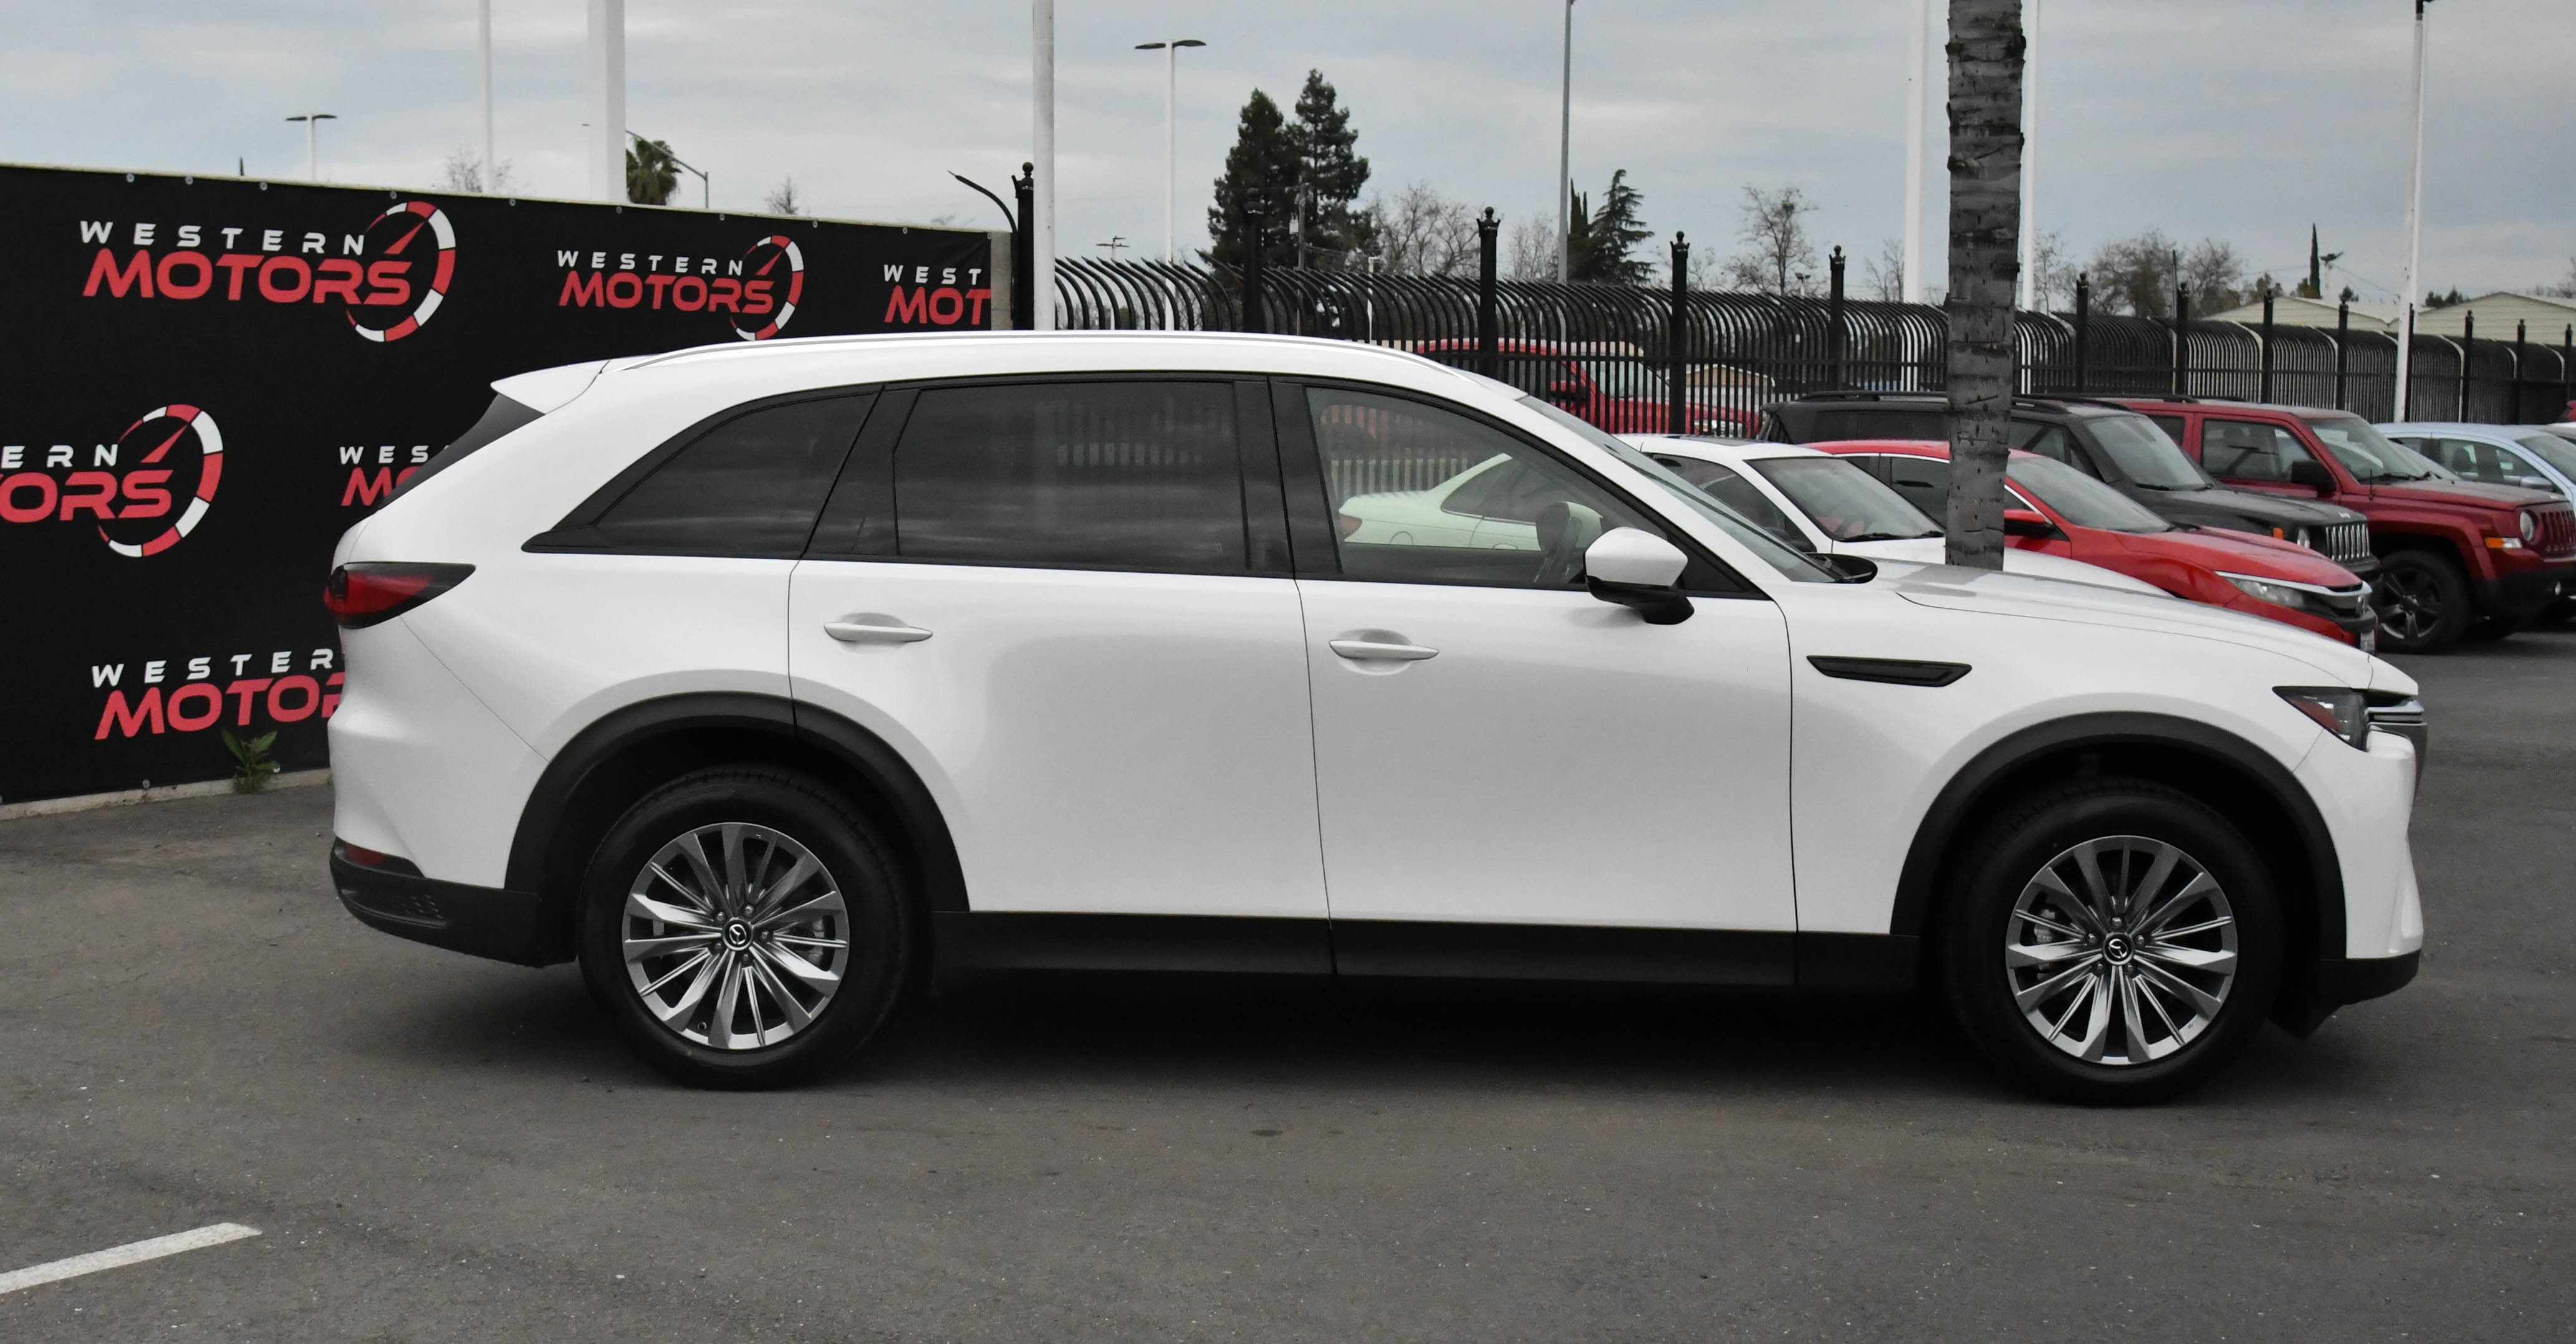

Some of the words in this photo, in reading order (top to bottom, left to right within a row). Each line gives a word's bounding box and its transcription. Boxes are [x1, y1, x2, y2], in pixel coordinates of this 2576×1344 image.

[80, 221, 365, 256] WESTERN
[82, 247, 412, 306] MOTORS
[557, 250, 743, 276] WESTERN
[883, 264, 982, 286] WEST
[558, 270, 775, 314] MOTORS
[884, 285, 991, 325] MOT
[1, 444, 118, 469] ERN
[339, 445, 449, 464] WES
[0, 469, 173, 523] ORS
[340, 466, 422, 506] M
[92, 648, 334, 688] WESTER
